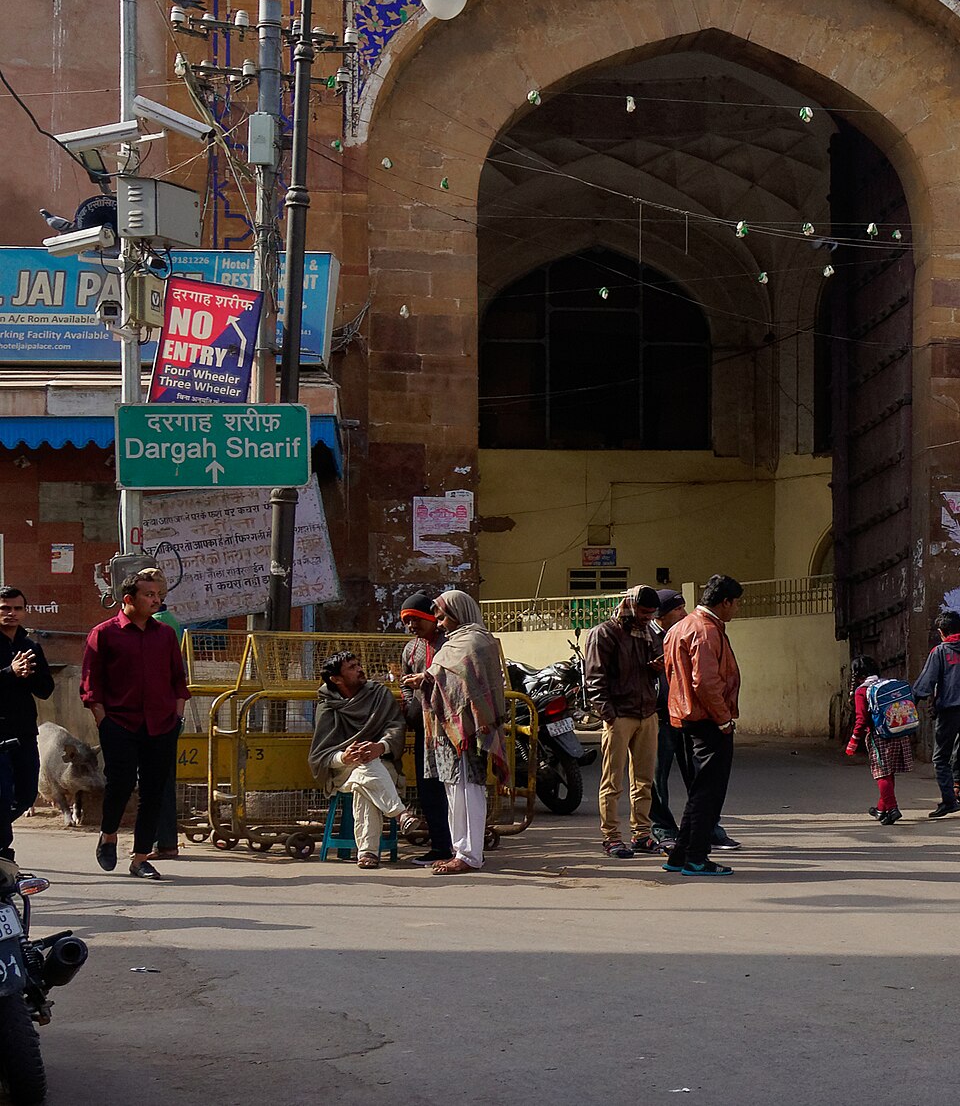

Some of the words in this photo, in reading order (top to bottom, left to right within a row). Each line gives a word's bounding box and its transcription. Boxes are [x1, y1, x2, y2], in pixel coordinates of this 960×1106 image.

[222, 258, 250, 270] Hotel
[309, 260, 318, 271] &
[12, 270, 66, 307] JAI
[172, 288, 212, 306] दरगाह
[215, 294, 254, 311] शरीफ
[51, 316, 95, 324] Available
[168, 306, 214, 340] NO
[0, 331, 24, 341] rking
[27, 331, 61, 341] Facility
[64, 331, 109, 340] Available
[162, 339, 228, 368] ENTRY
[164, 364, 190, 378] Four
[193, 368, 240, 385] Wheeler
[159, 376, 191, 390] Three
[194, 381, 242, 397] Wheeler
[145, 413, 213, 433] दरगाह
[125, 437, 216, 464] Dargah
[226, 437, 301, 458] Sharif
